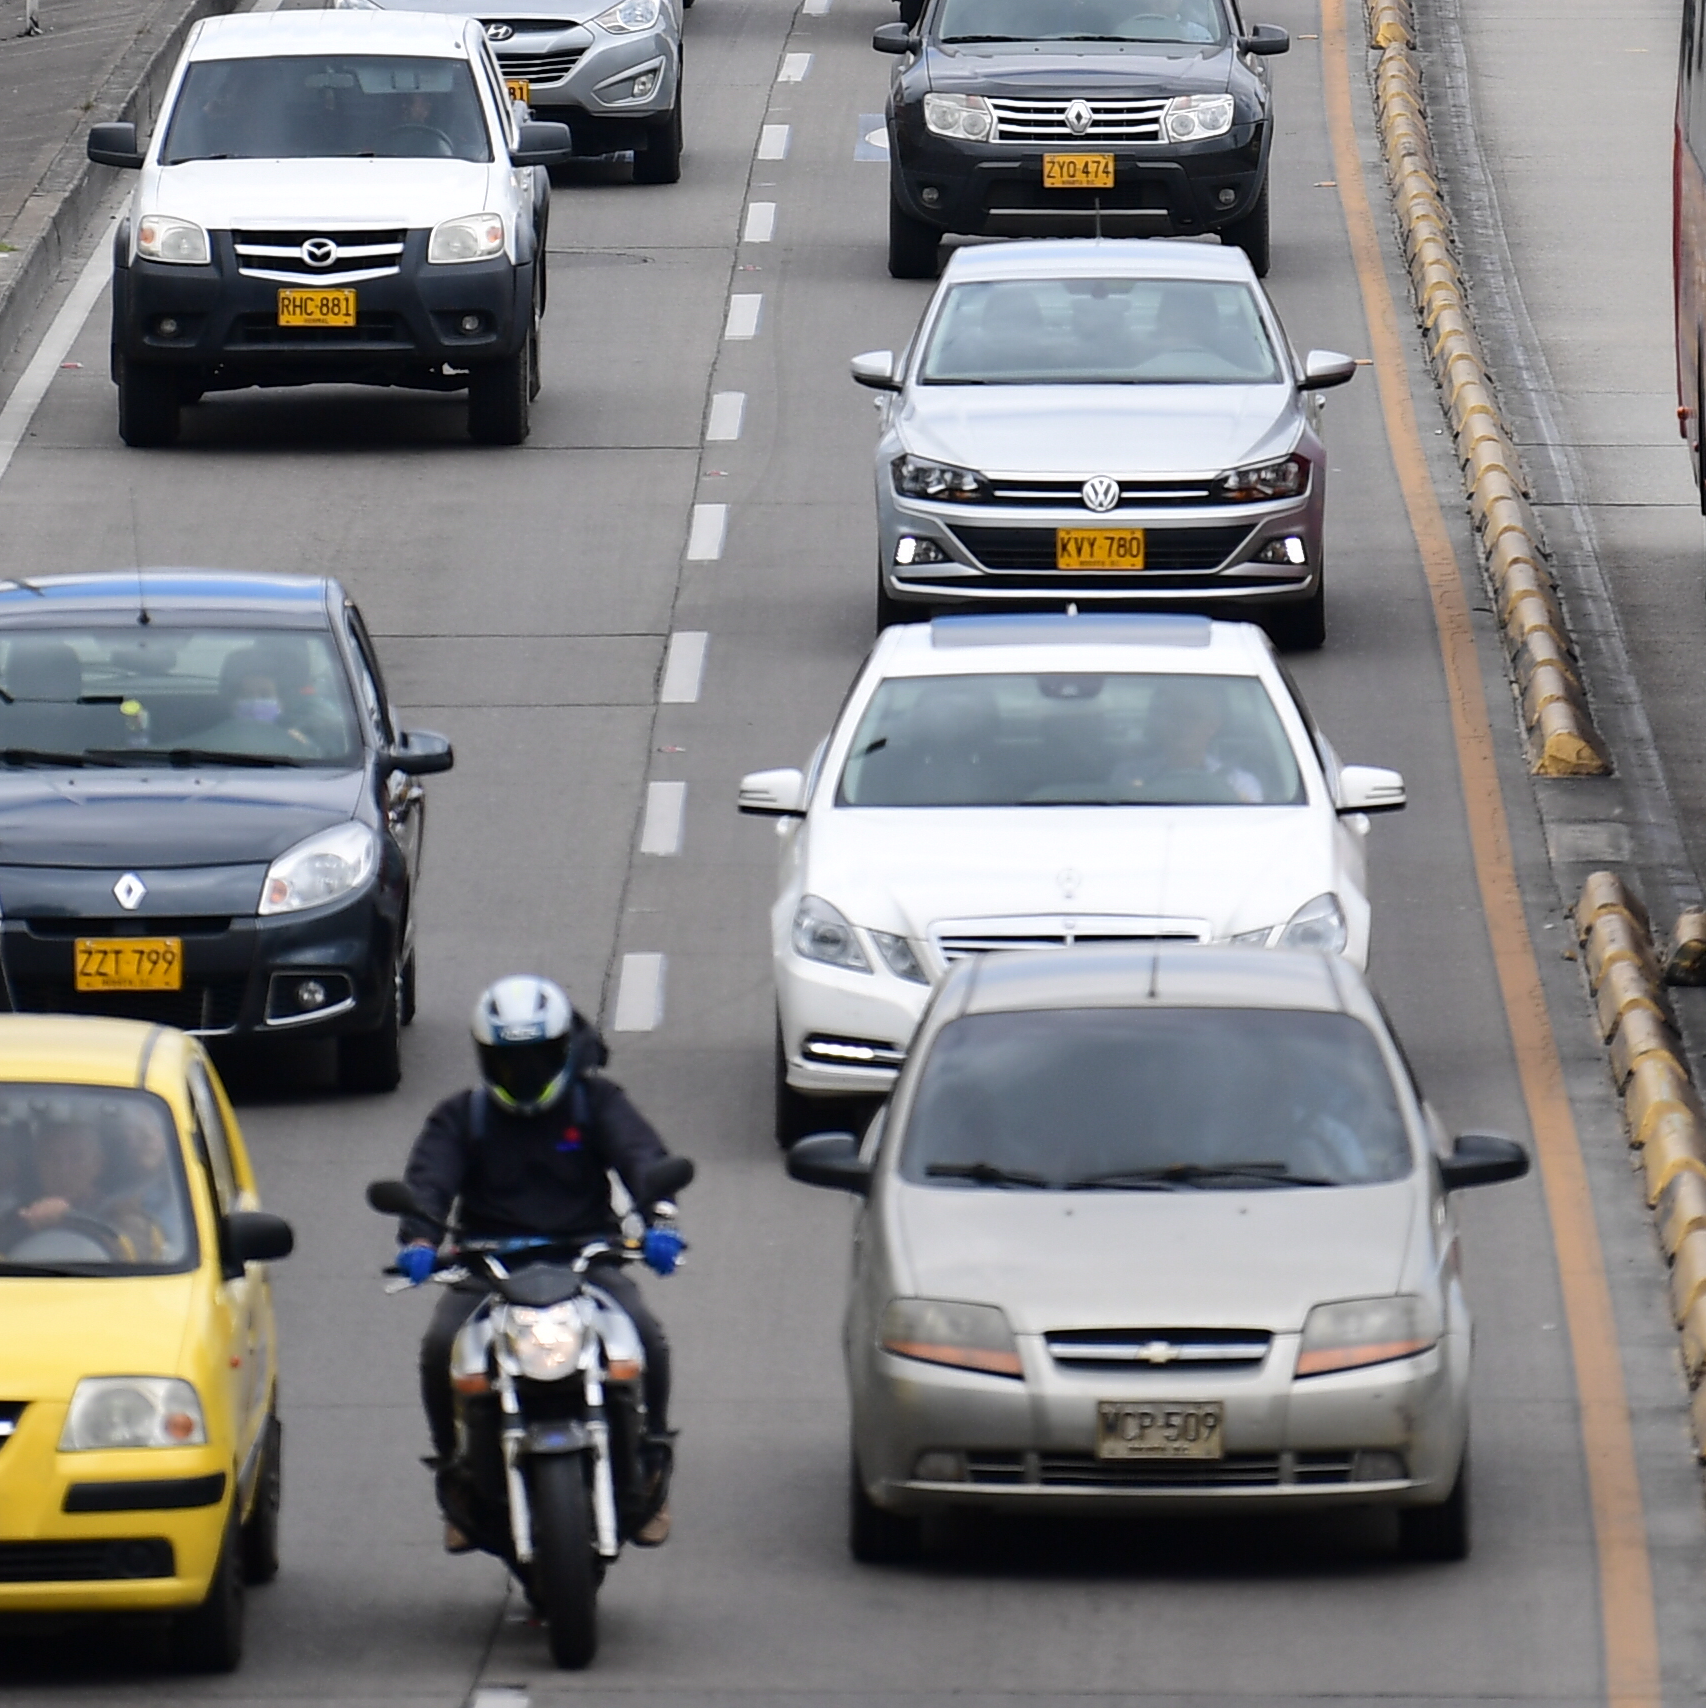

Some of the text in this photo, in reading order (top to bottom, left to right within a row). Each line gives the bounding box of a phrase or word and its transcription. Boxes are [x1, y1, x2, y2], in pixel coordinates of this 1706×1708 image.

[280, 296, 352, 317] RHC-881
[1060, 536, 1141, 558] KVY-780
[79, 949, 176, 976] ZZT-799
